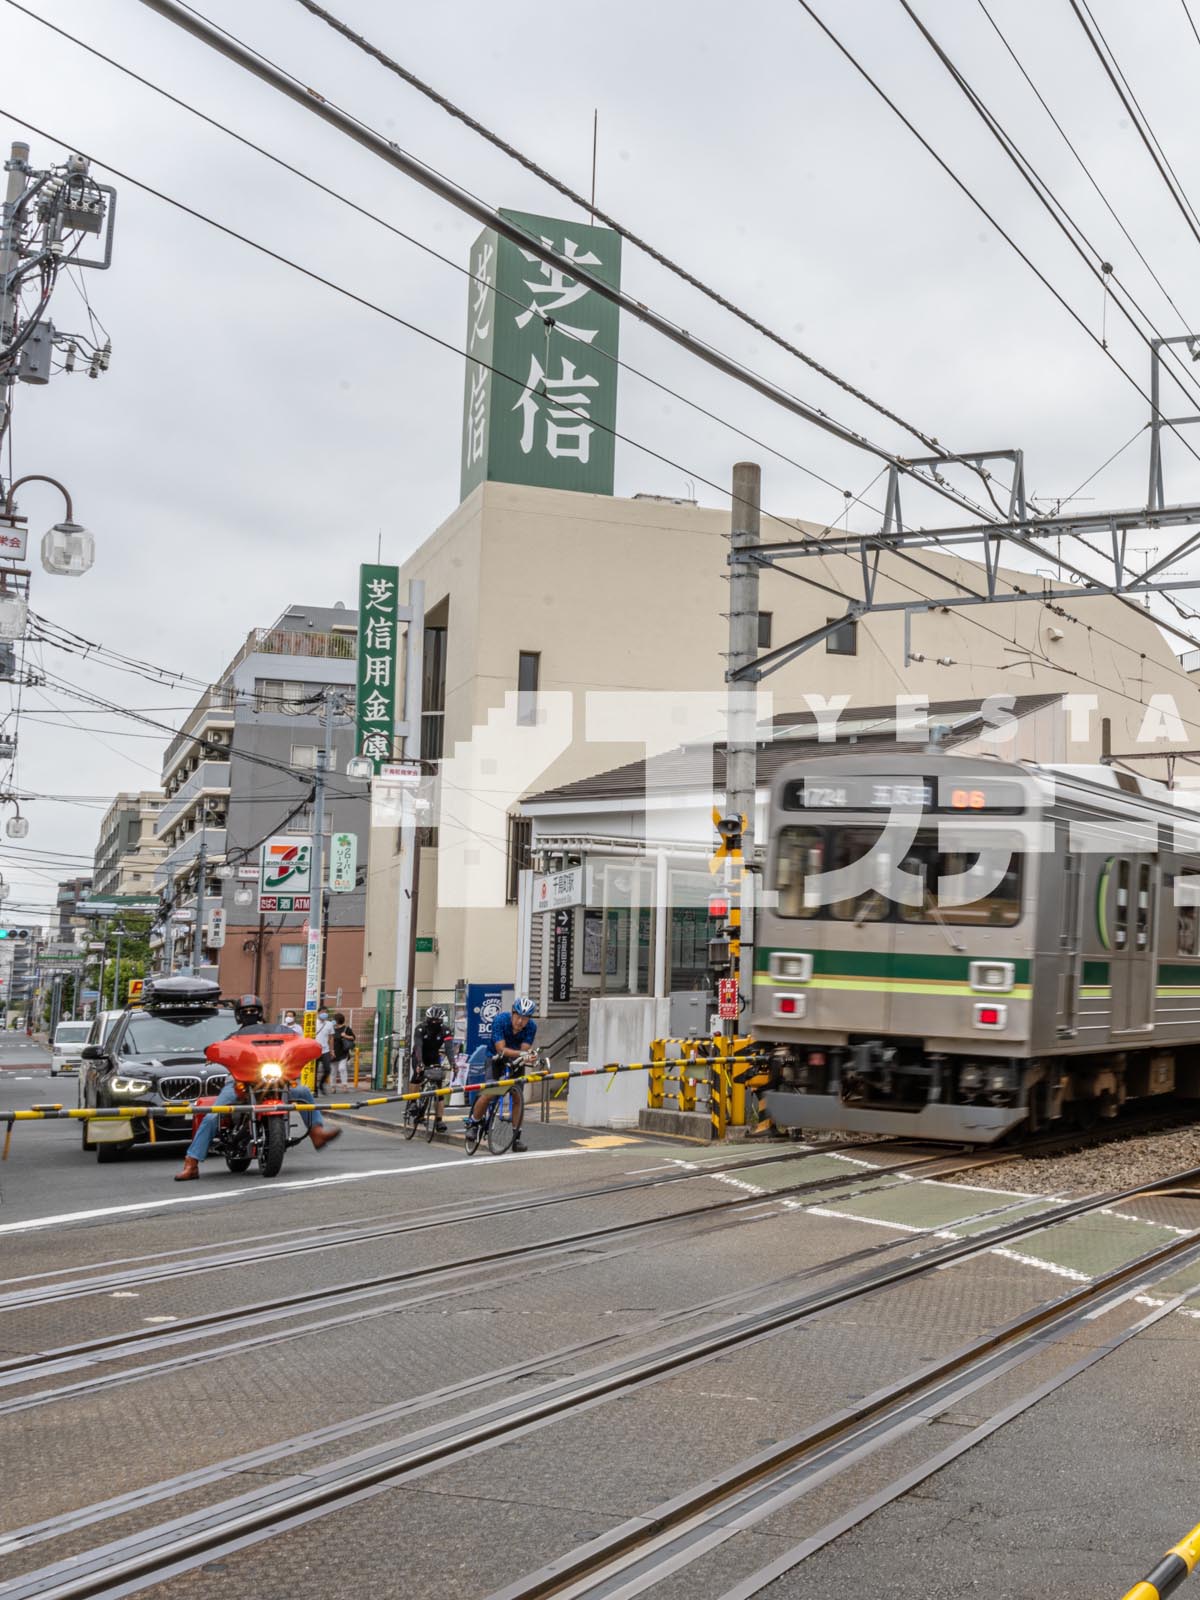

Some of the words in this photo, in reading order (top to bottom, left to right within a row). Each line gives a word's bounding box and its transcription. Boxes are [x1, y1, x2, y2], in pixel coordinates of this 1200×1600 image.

[467, 243, 495, 471] 芝信
[511, 234, 603, 465] 芝信
[363, 578, 395, 762] 芝信用金庫
[261, 899, 276, 909] たばこ
[280, 899, 291, 909] 酒
[294, 899, 310, 909] ATM
